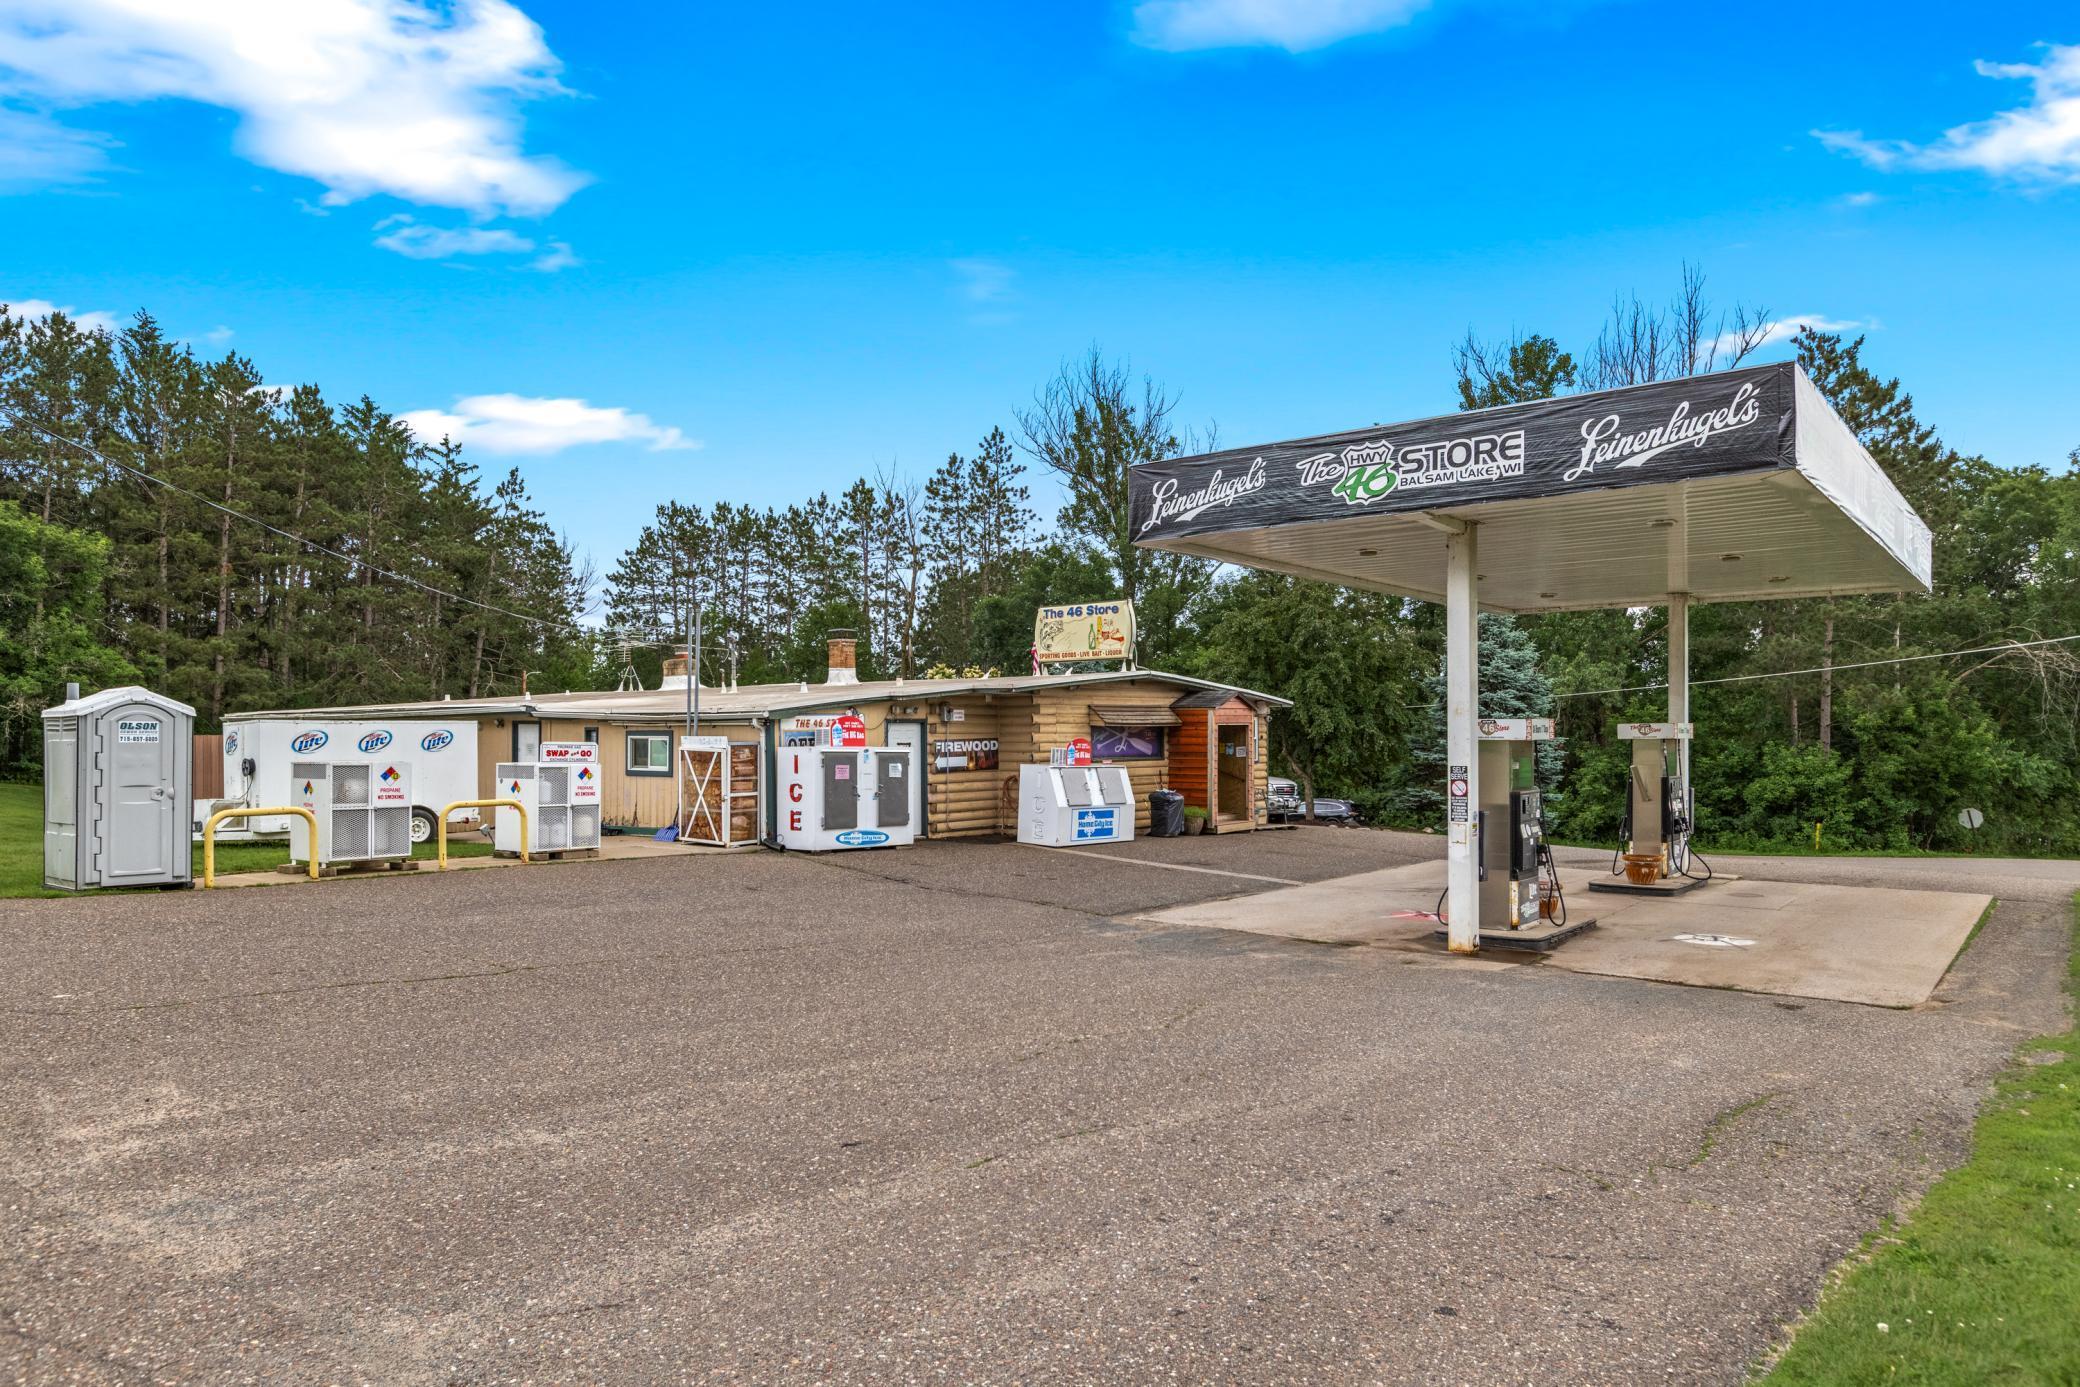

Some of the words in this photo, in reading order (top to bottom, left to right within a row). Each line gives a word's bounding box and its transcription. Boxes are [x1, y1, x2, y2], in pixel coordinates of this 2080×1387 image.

[1563, 382, 1761, 482] Leinenkugel's
[1350, 450, 1386, 465] HWY
[1399, 432, 1523, 475] STORE
[1296, 453, 1344, 486] The
[1400, 471, 1455, 488] BALSAM
[1503, 461, 1522, 474] WI
[1334, 462, 1397, 502] 46
[1141, 457, 1267, 532] Leinenkugel's
[1043, 608, 1064, 619] The
[1067, 606, 1083, 617] 46
[1086, 604, 1120, 616] Store
[1040, 652, 1060, 660] SPORTING
[1105, 648, 1123, 656] LIQUOR
[120, 722, 158, 730] OLSON
[796, 719, 810, 728] THE
[814, 718, 824, 728] 46
[1482, 723, 1495, 733] 46
[1640, 726, 1650, 734] 46
[297, 736, 324, 752] Lite
[364, 736, 388, 752] Lite
[426, 735, 449, 750] Lite
[936, 740, 999, 753] FIREWOOD
[546, 749, 570, 757] SWAP
[789, 754, 803, 832] ICE
[1078, 820, 1094, 828] Home
[1094, 820, 1105, 829] City
